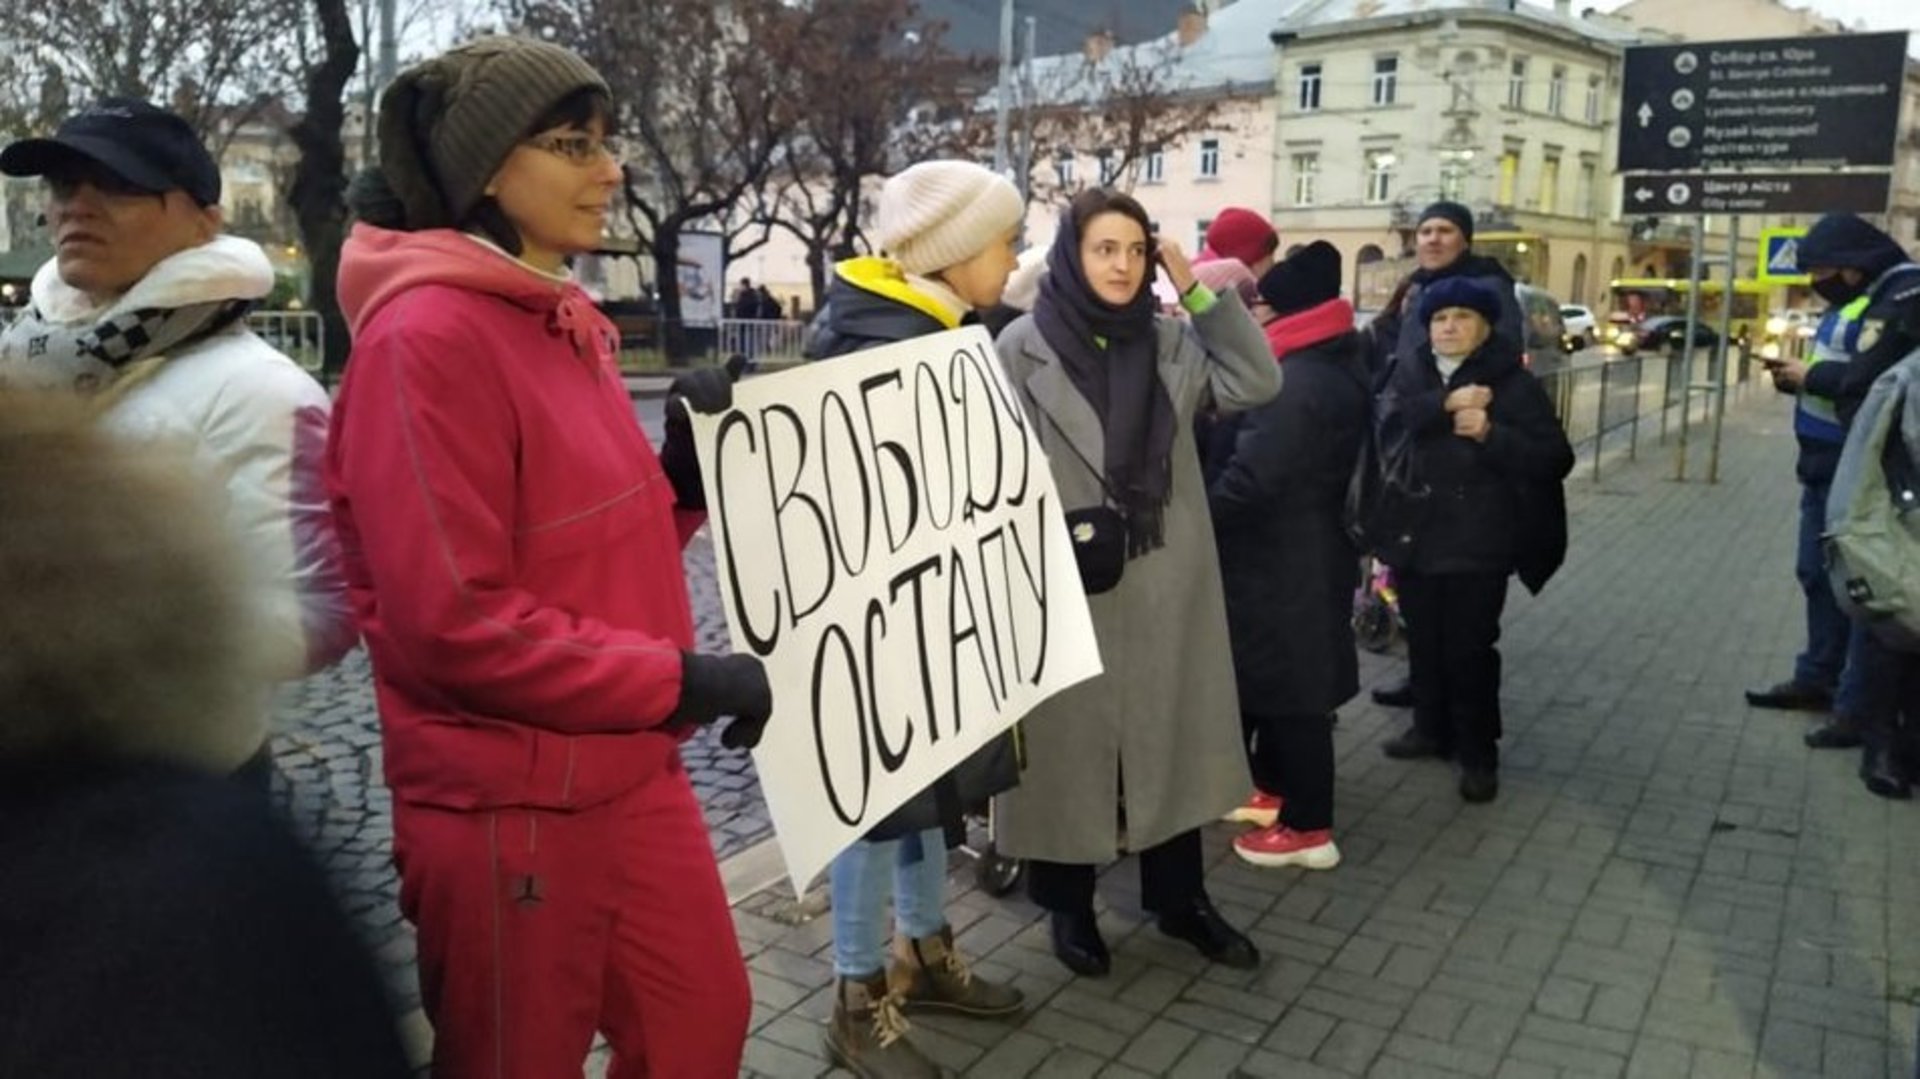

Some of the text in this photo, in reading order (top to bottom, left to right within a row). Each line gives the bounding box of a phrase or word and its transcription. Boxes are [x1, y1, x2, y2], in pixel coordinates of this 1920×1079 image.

[1703, 179, 1791, 195] Центр міста
[715, 342, 1029, 657] СВОБОДУ
[811, 494, 1048, 827] ОСТАПУ
